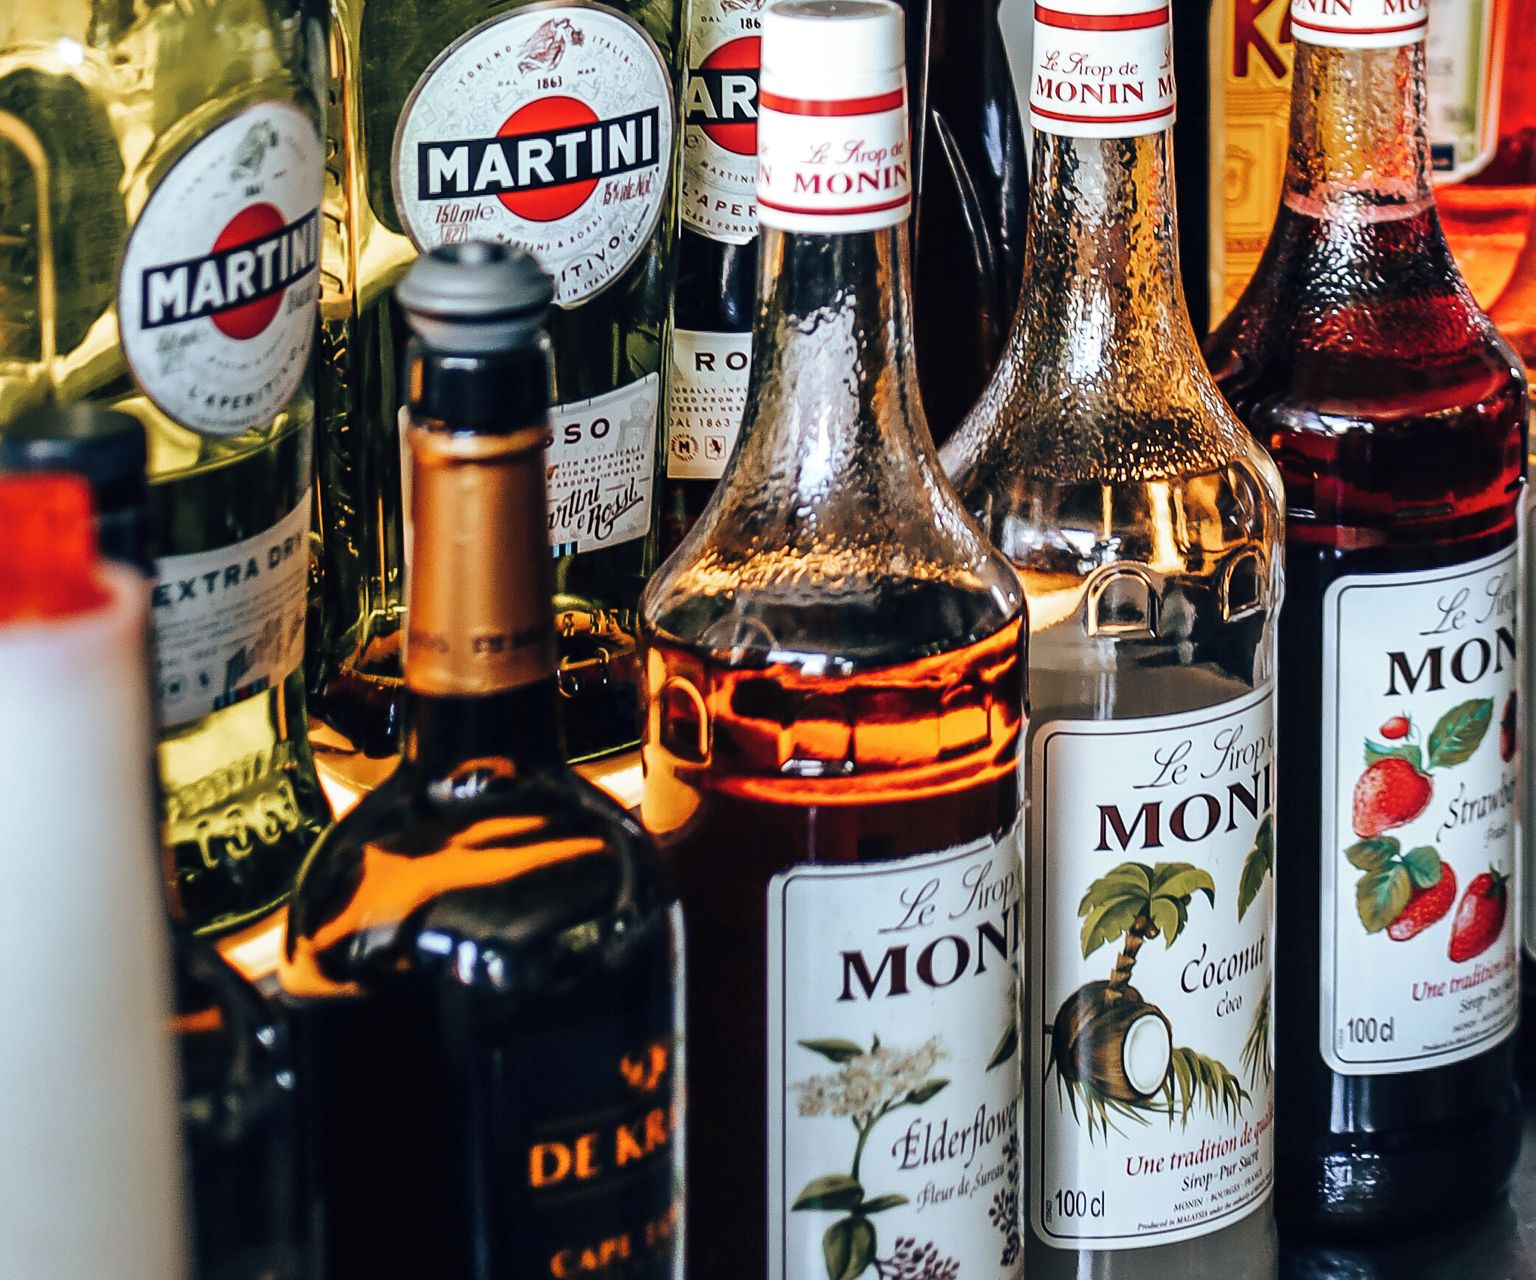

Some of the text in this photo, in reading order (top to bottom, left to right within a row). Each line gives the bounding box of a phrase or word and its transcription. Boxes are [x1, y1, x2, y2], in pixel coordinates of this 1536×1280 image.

[1039, 49, 1061, 71] Le
[1118, 60, 1139, 76] de
[536, 76, 563, 91] 1863
[1035, 74, 1145, 105] MONIN
[426, 114, 654, 196] MARTINI
[800, 141, 833, 165] Le
[793, 160, 909, 195] MONIN
[147, 215, 318, 325] MARTINI
[698, 416, 732, 429] 1863
[1419, 586, 1470, 636] Le
[1132, 723, 1266, 789] Le Sirop
[1093, 761, 1272, 852] MONI
[877, 859, 1015, 935] Le Sirop
[1180, 931, 1265, 994] Coconut
[1215, 989, 1243, 1018] Coco
[1346, 1017, 1378, 1044] 100
[1126, 1154, 1165, 1178] Une
[1169, 1134, 1239, 1172] tradition
[1054, 1189, 1088, 1218] 100
[1090, 1188, 1106, 1218] cl
[1172, 1196, 1204, 1214] MONIN
